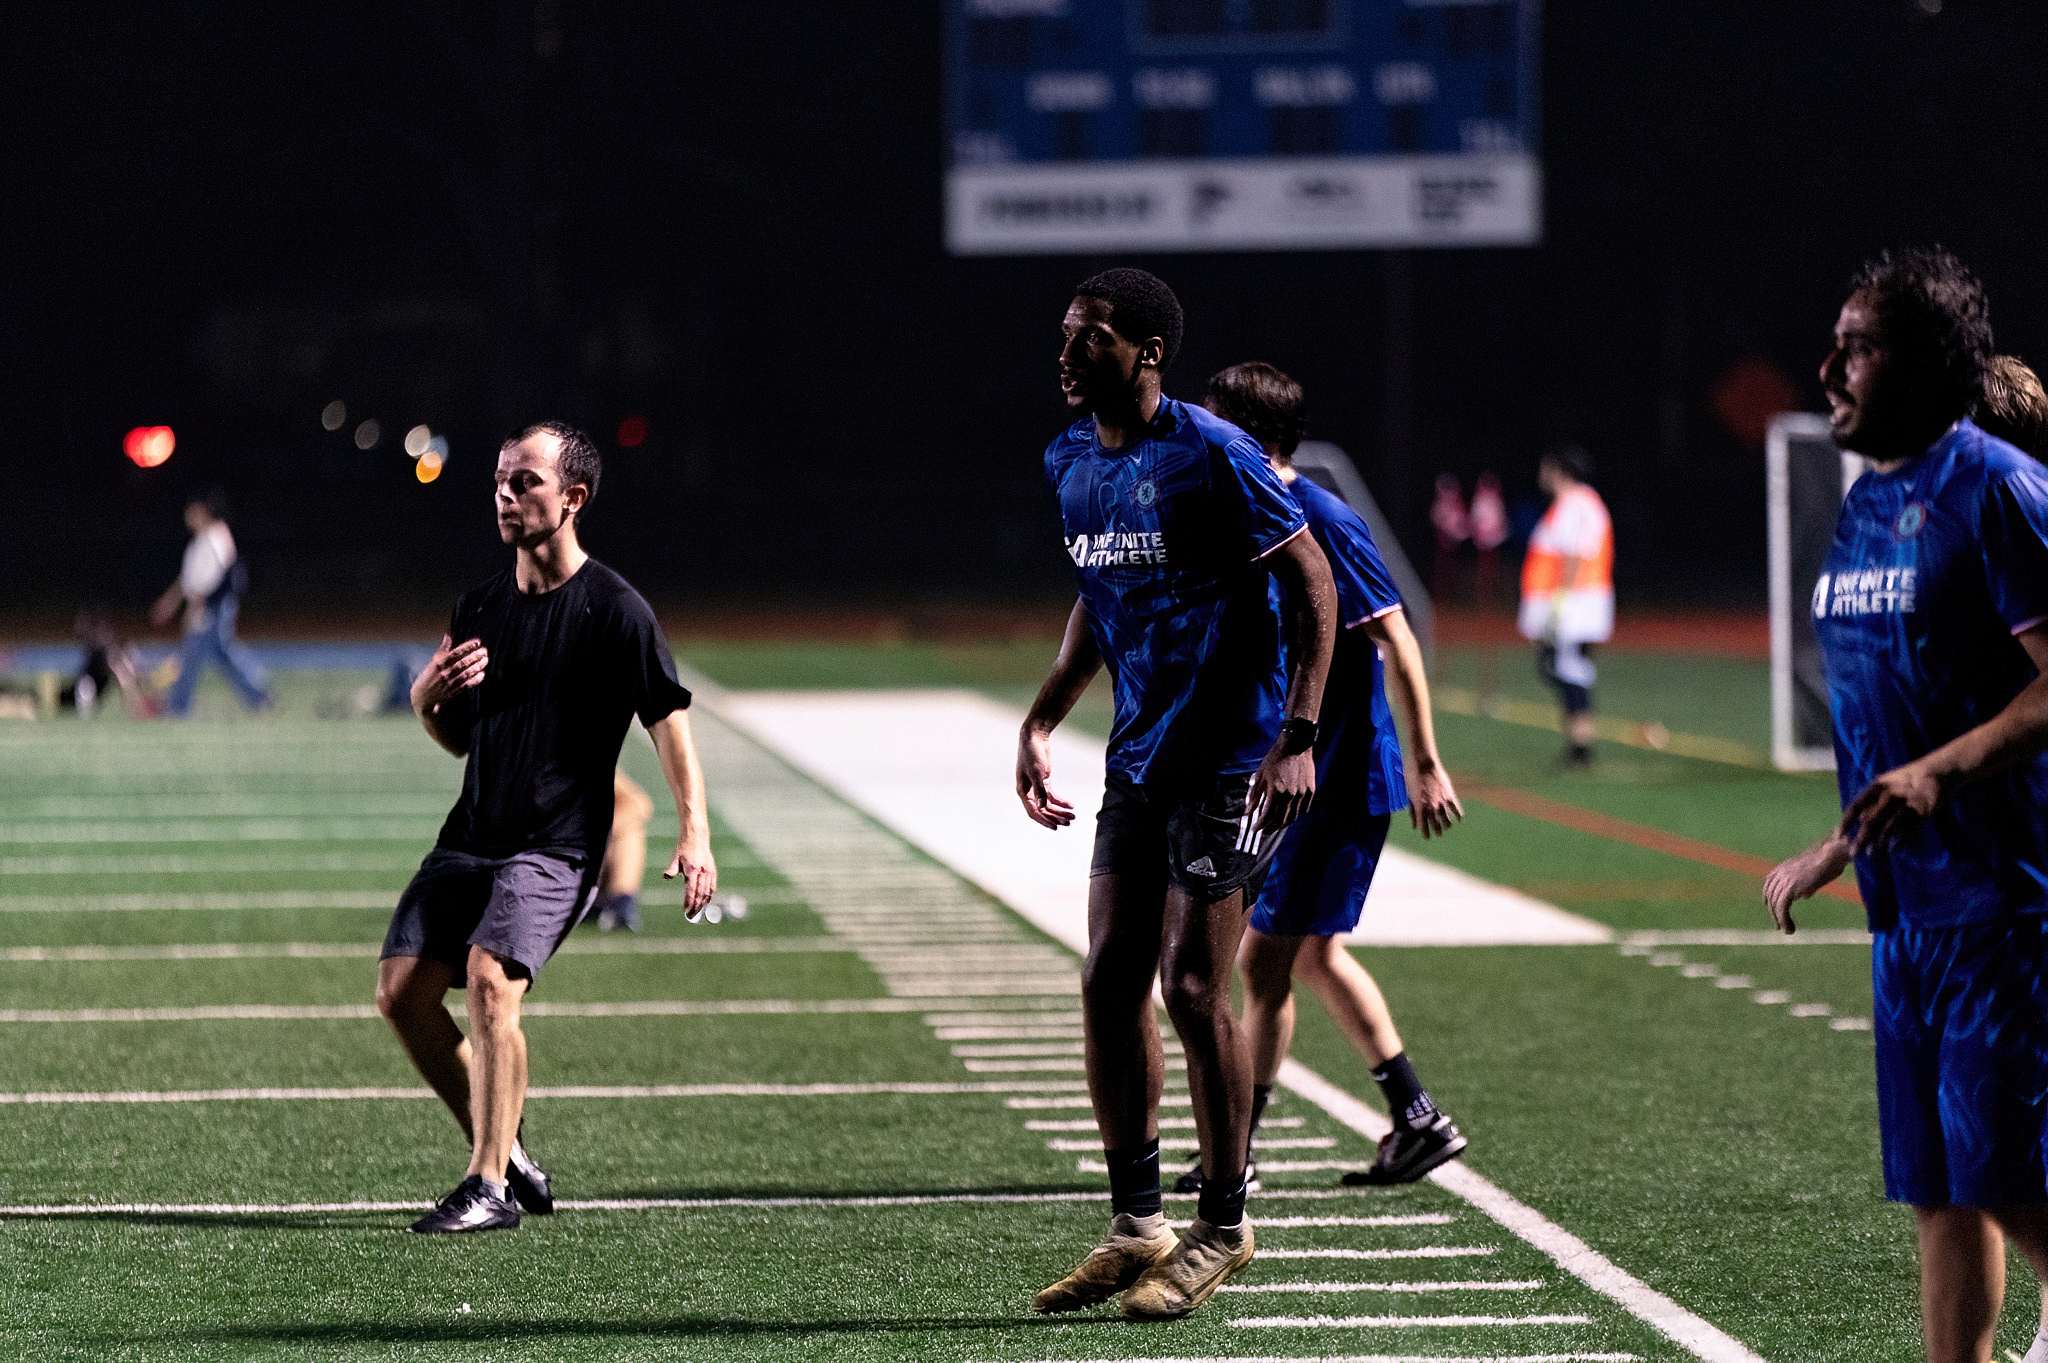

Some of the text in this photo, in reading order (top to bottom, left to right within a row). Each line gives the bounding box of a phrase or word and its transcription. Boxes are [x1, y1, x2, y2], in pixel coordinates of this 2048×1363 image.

[1093, 532, 1165, 550] INFINITE
[1087, 549, 1168, 567] ATHLETE
[1831, 590, 1916, 617] ATHLETE
